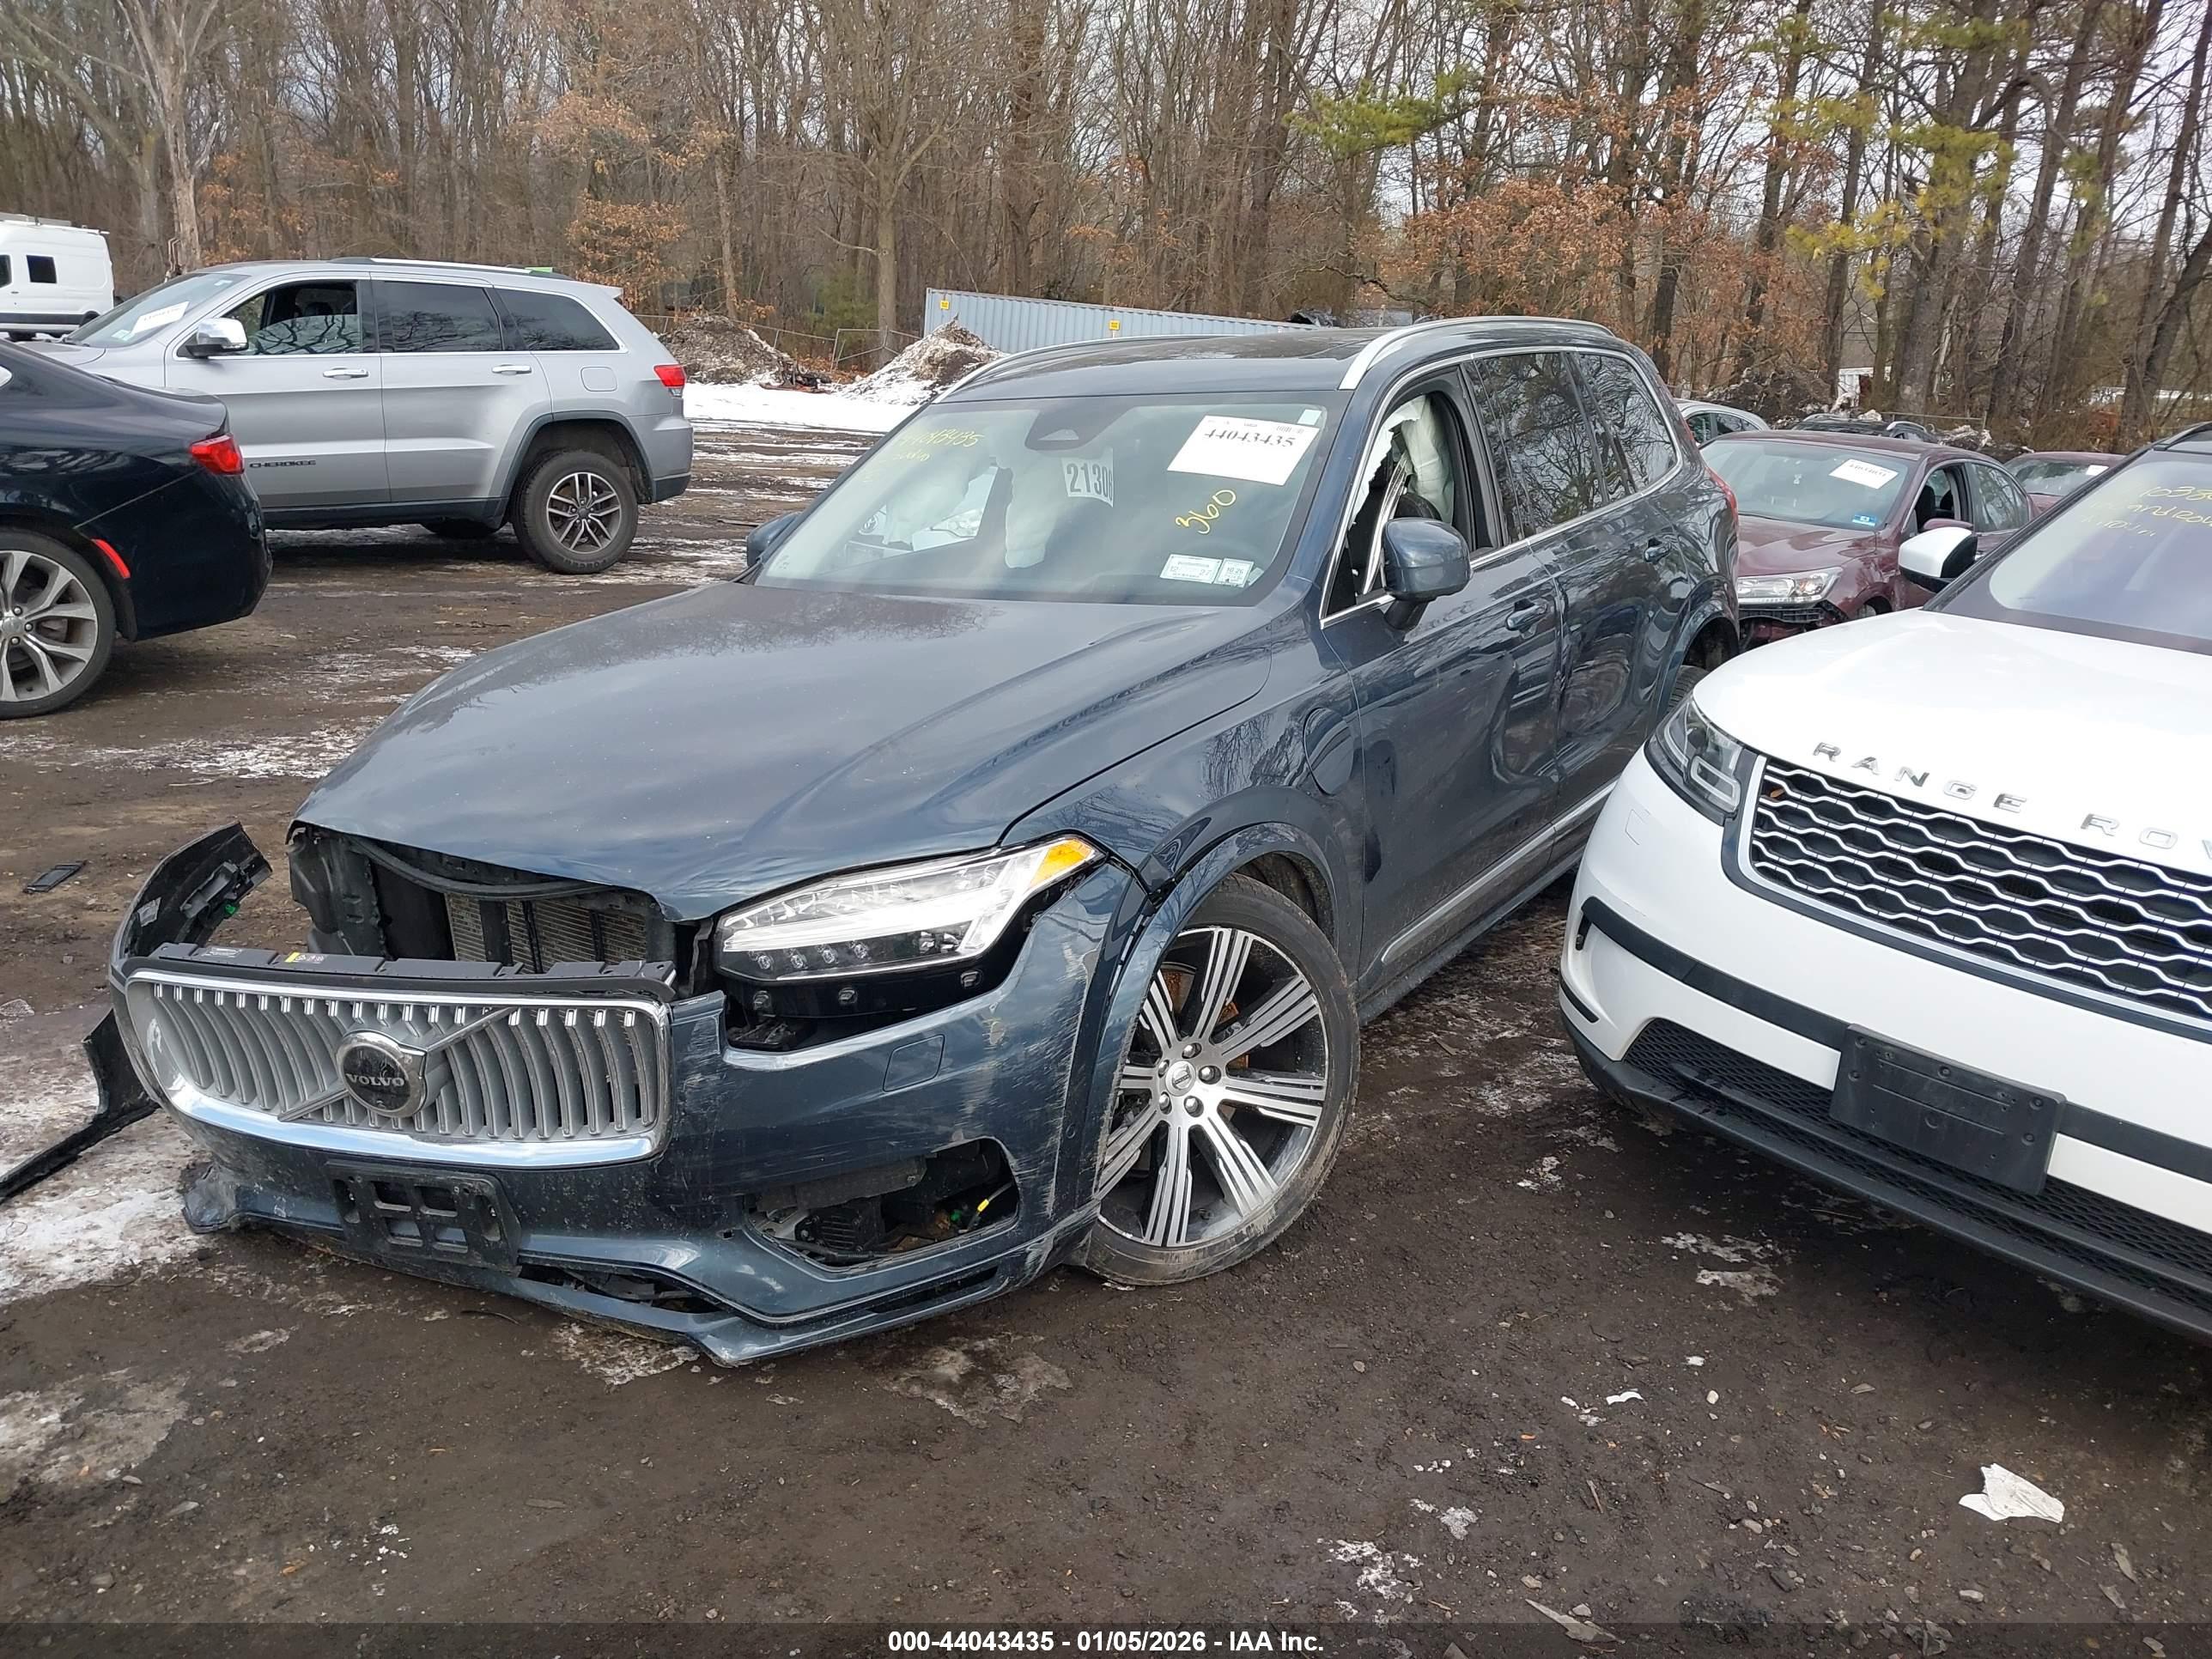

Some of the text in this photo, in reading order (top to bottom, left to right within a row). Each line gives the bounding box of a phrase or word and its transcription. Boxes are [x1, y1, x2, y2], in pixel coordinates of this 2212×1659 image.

[1204, 428, 1297, 447] 44043435
[249, 459, 317, 468] CHEROKEE
[1175, 489, 1237, 535] 360
[1811, 741, 2212, 860] RANGE RO
[345, 1073, 405, 1086] VOLVO
